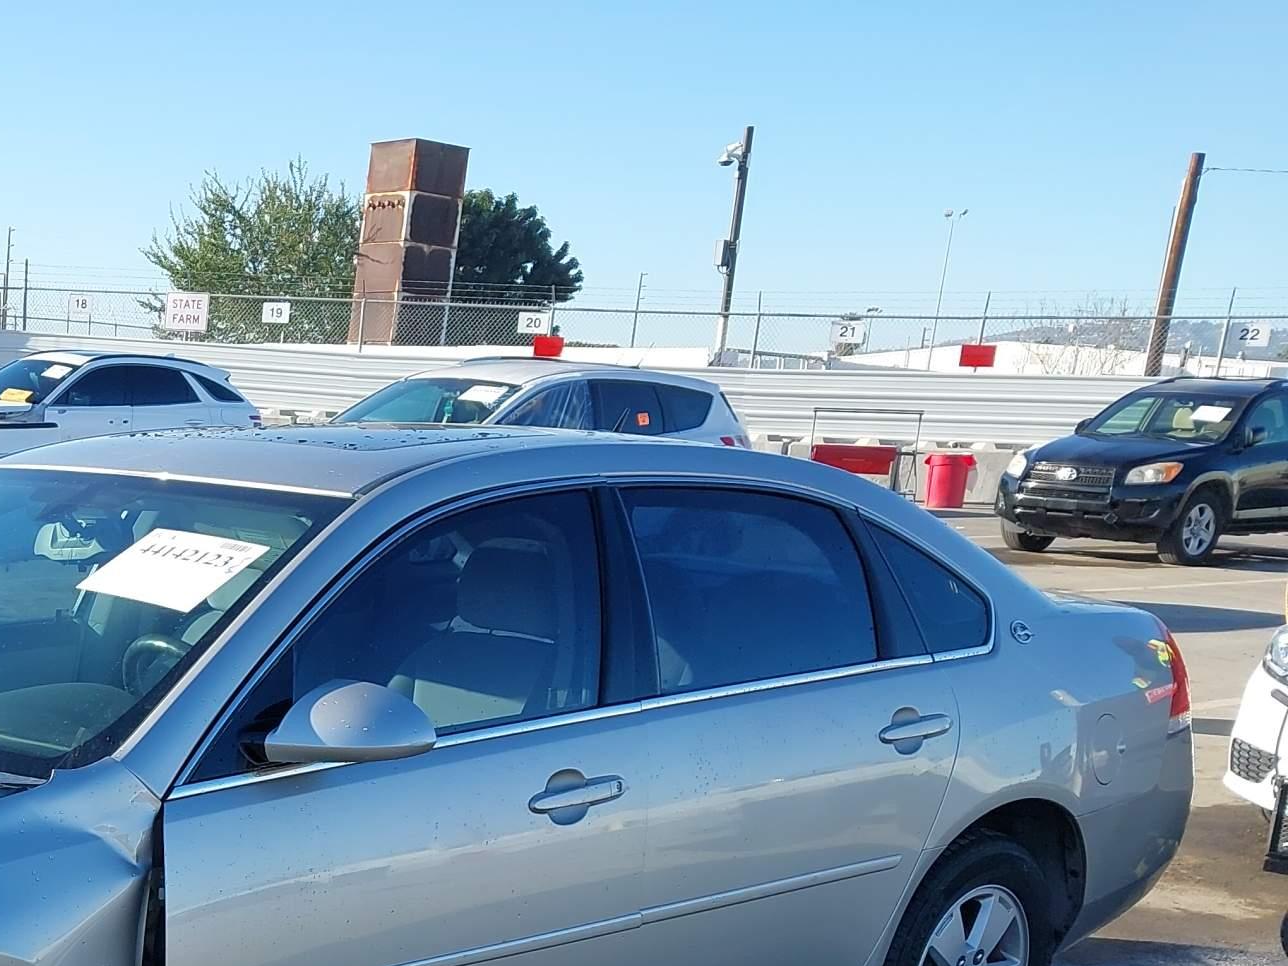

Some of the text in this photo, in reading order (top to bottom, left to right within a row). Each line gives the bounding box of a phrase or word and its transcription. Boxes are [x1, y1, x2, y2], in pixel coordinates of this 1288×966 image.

[75, 299, 88, 309] 18
[172, 299, 203, 309] STATE
[269, 307, 283, 318] 19
[172, 314, 200, 325] FARM
[526, 317, 542, 328] 20
[839, 325, 856, 338] 21
[1239, 328, 1260, 341] 22
[140, 544, 234, 567] 44142123
